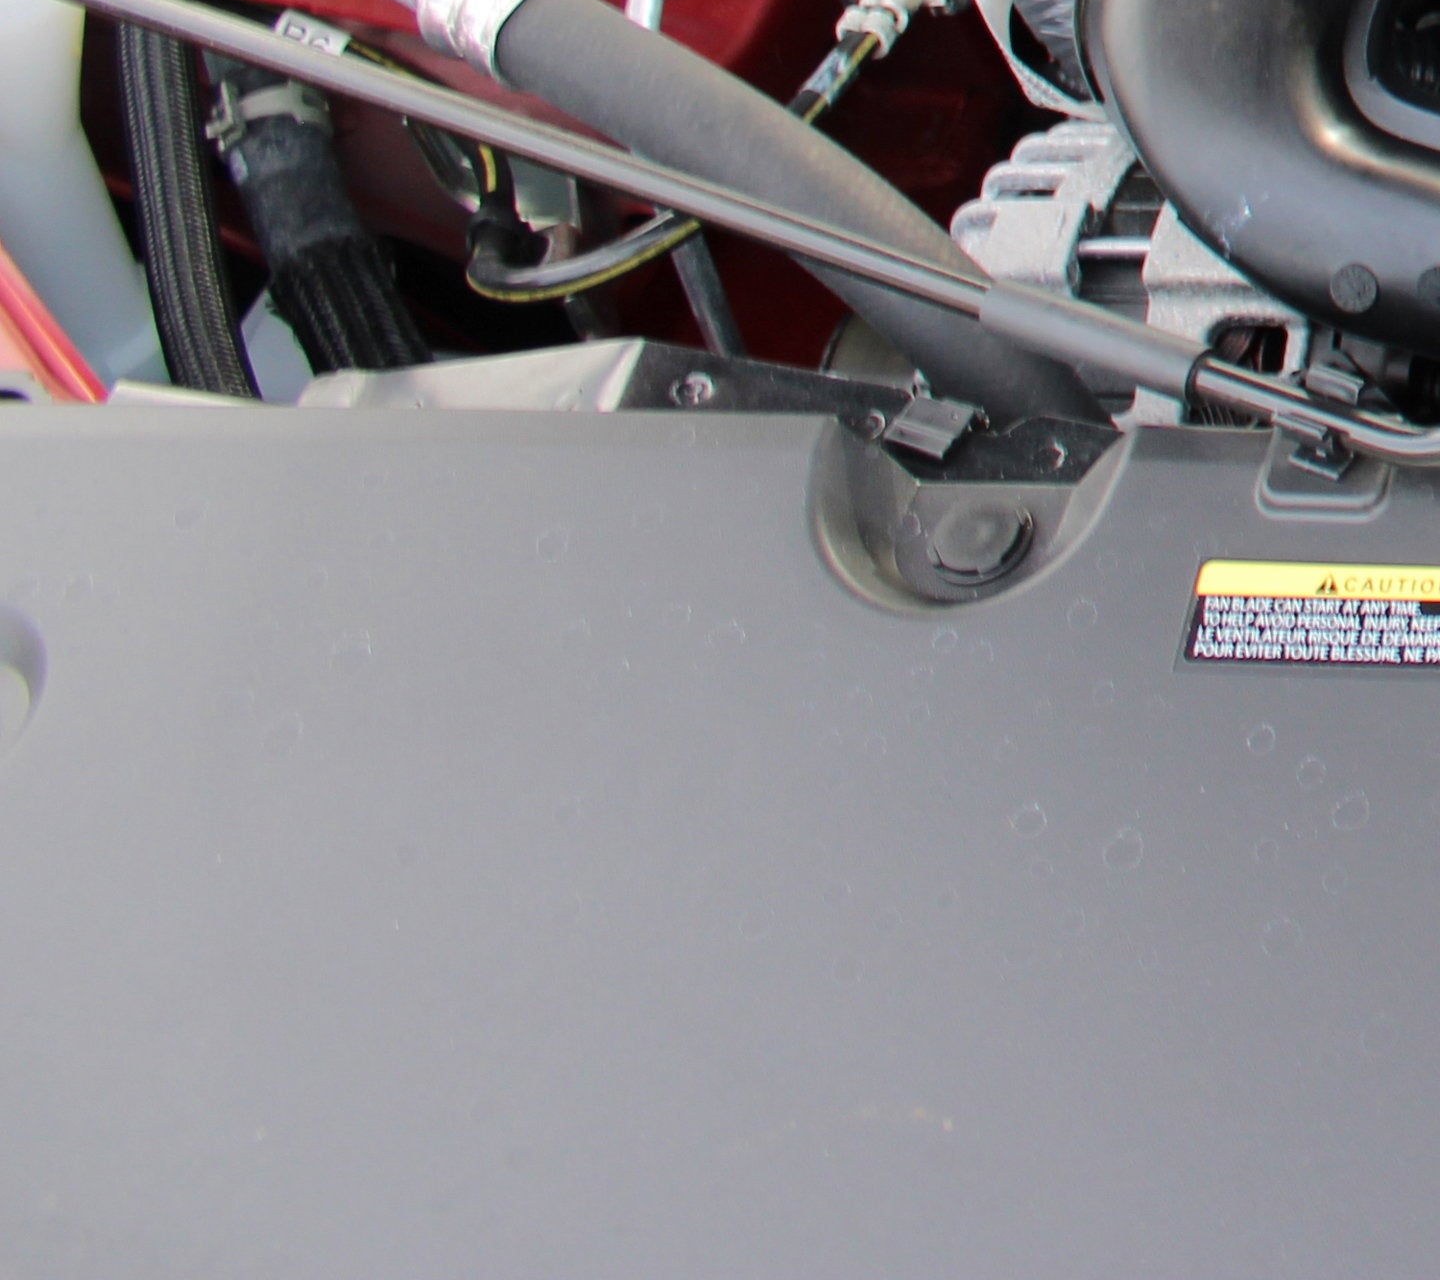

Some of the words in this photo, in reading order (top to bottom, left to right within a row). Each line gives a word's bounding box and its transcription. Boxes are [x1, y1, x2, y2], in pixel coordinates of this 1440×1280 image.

[1204, 597, 1230, 612] FAN
[1231, 597, 1272, 613] BLADE
[1274, 598, 1302, 614] CAN
[1303, 599, 1343, 615] START
[1342, 600, 1360, 615] AT
[1360, 601, 1388, 616] ANY
[1203, 611, 1220, 626] TO
[1221, 611, 1254, 627] HELP
[1255, 613, 1296, 629] AVOID
[1297, 614, 1361, 631] PERSONAL
[1196, 626, 1215, 641] LE
[1215, 626, 1306, 644] VENTILATEUR
[1308, 629, 1360, 646] RISQUE
[1360, 630, 1381, 646] DE
[1193, 642, 1234, 658] POUR
[1283, 643, 1330, 660] TOUTE
[1402, 646, 1425, 662] NE
